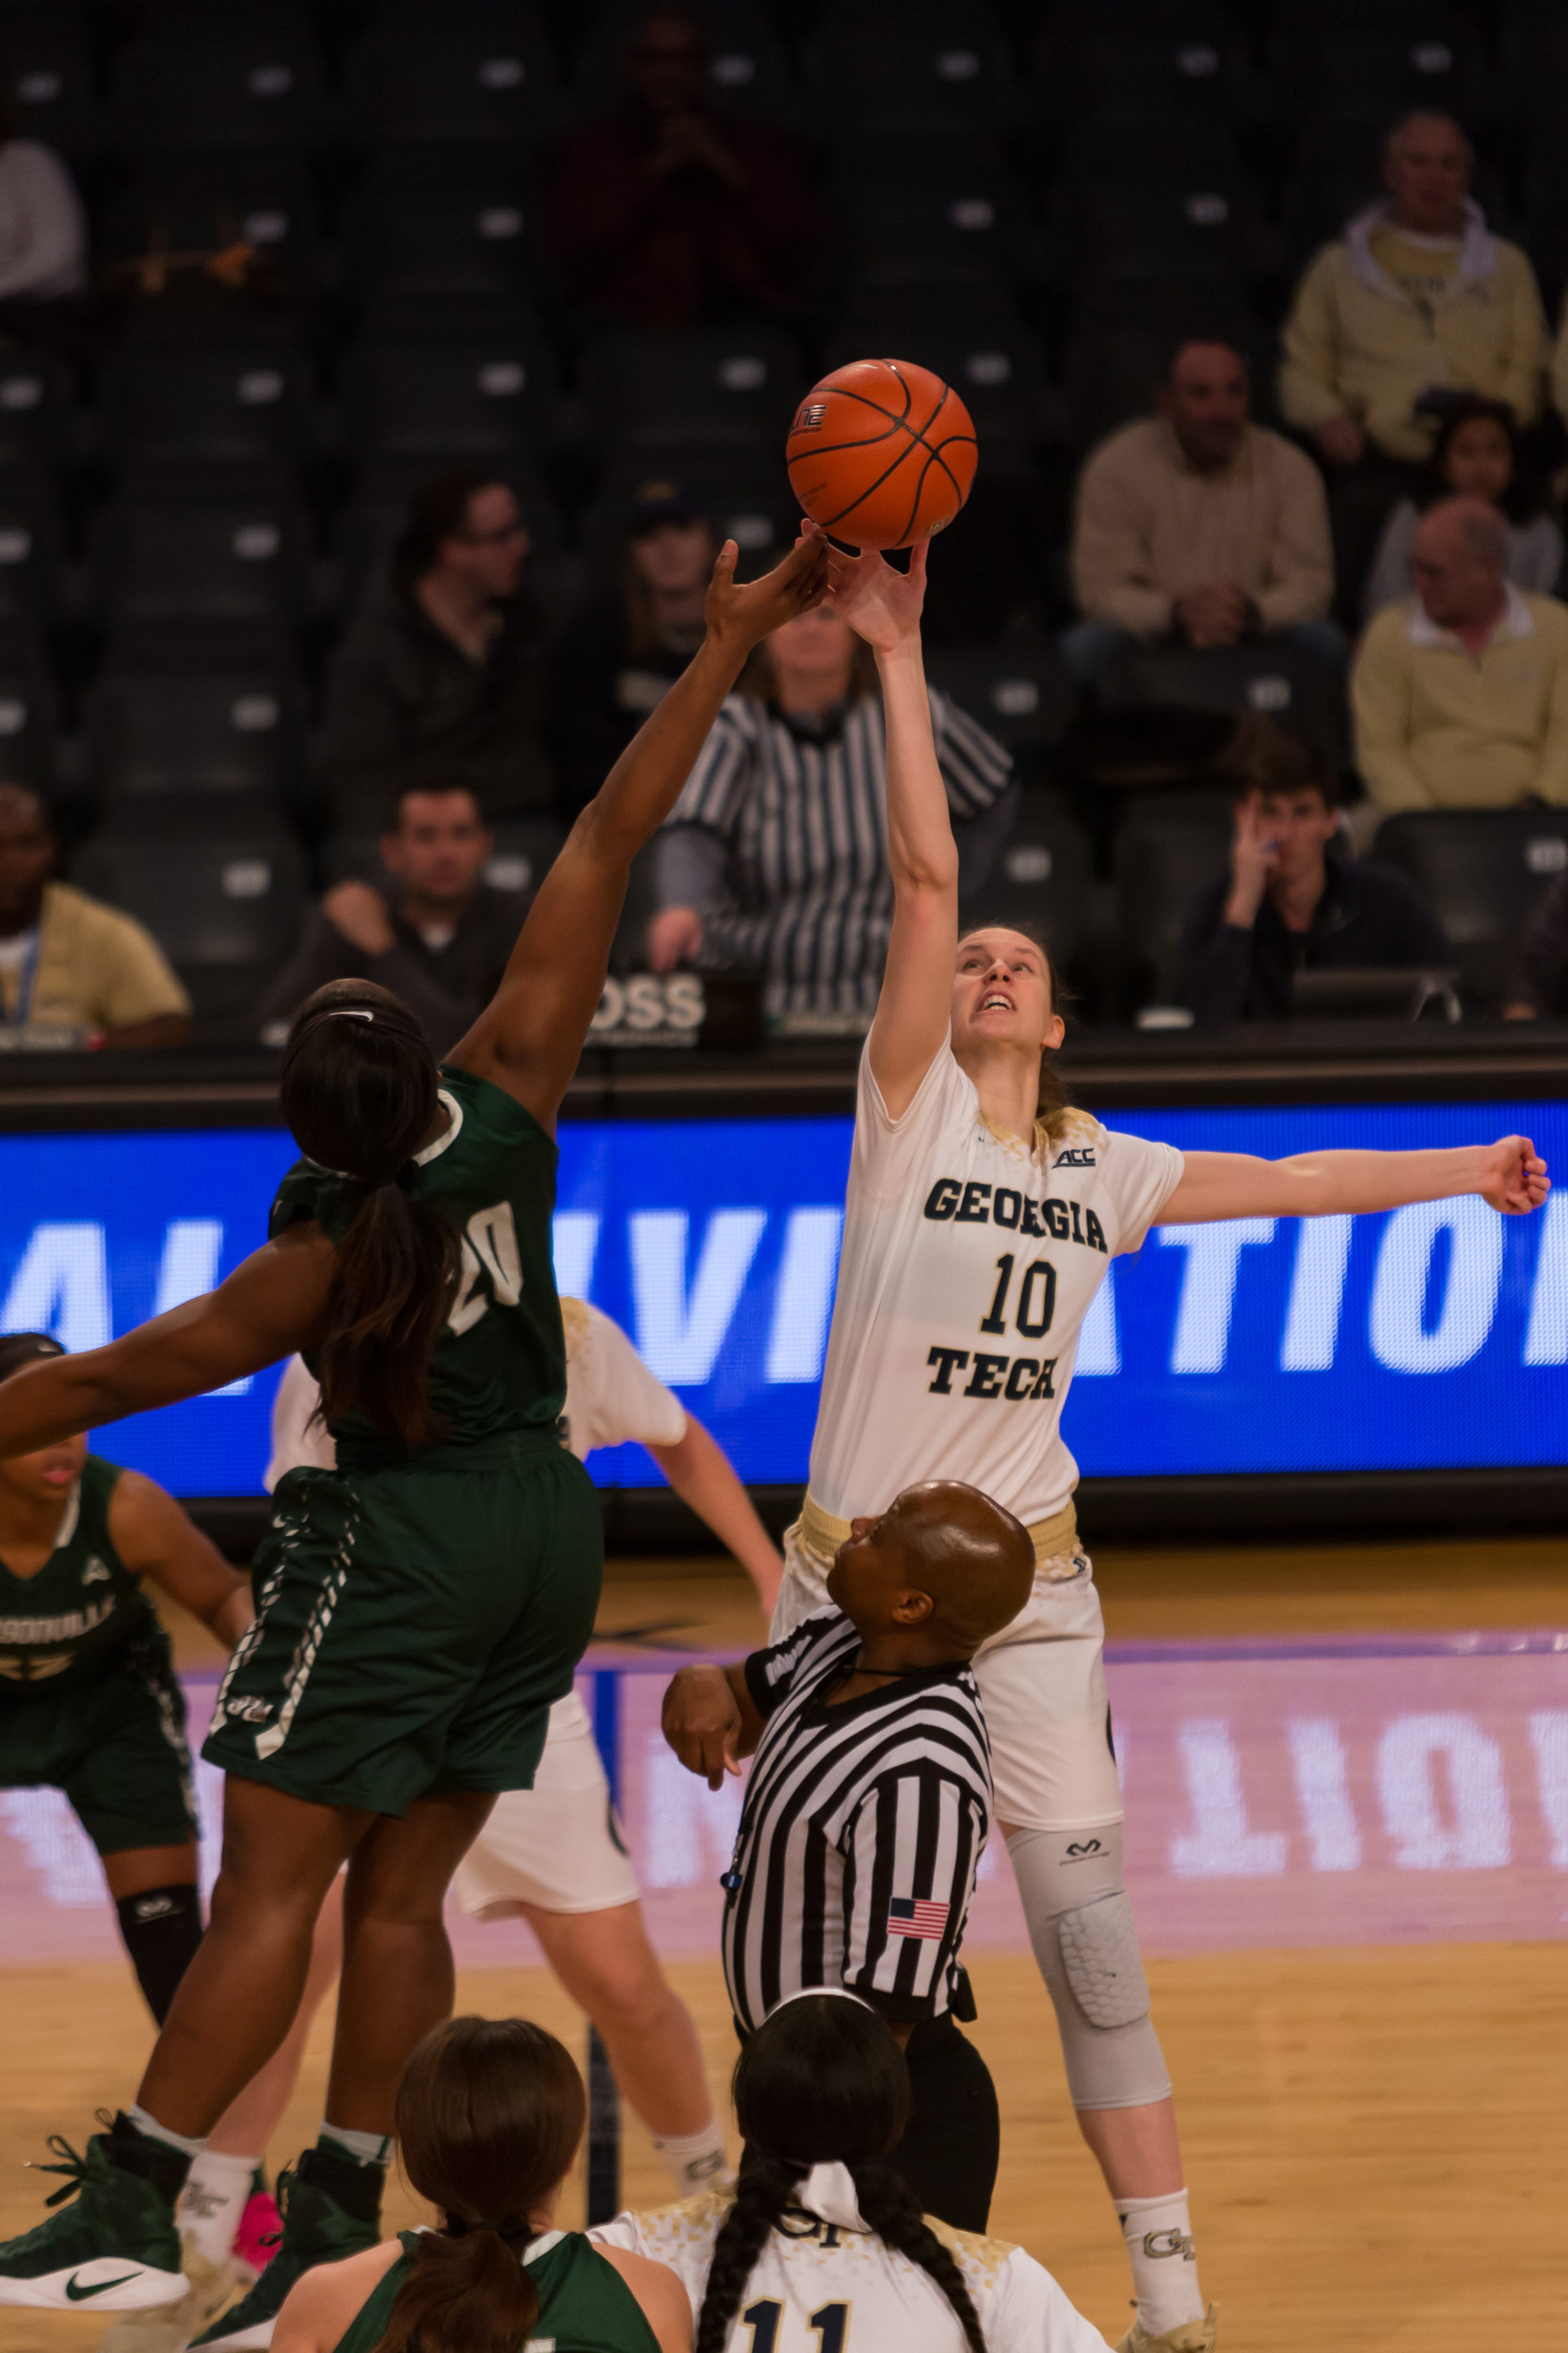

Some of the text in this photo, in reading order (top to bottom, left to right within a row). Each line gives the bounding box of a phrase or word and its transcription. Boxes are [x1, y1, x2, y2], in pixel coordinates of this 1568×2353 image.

[1051, 1148, 1096, 1169] ACC
[923, 1177, 1109, 1255] GEORGIA
[979, 1252, 1058, 1341] 10
[926, 1345, 1059, 1402] TECH
